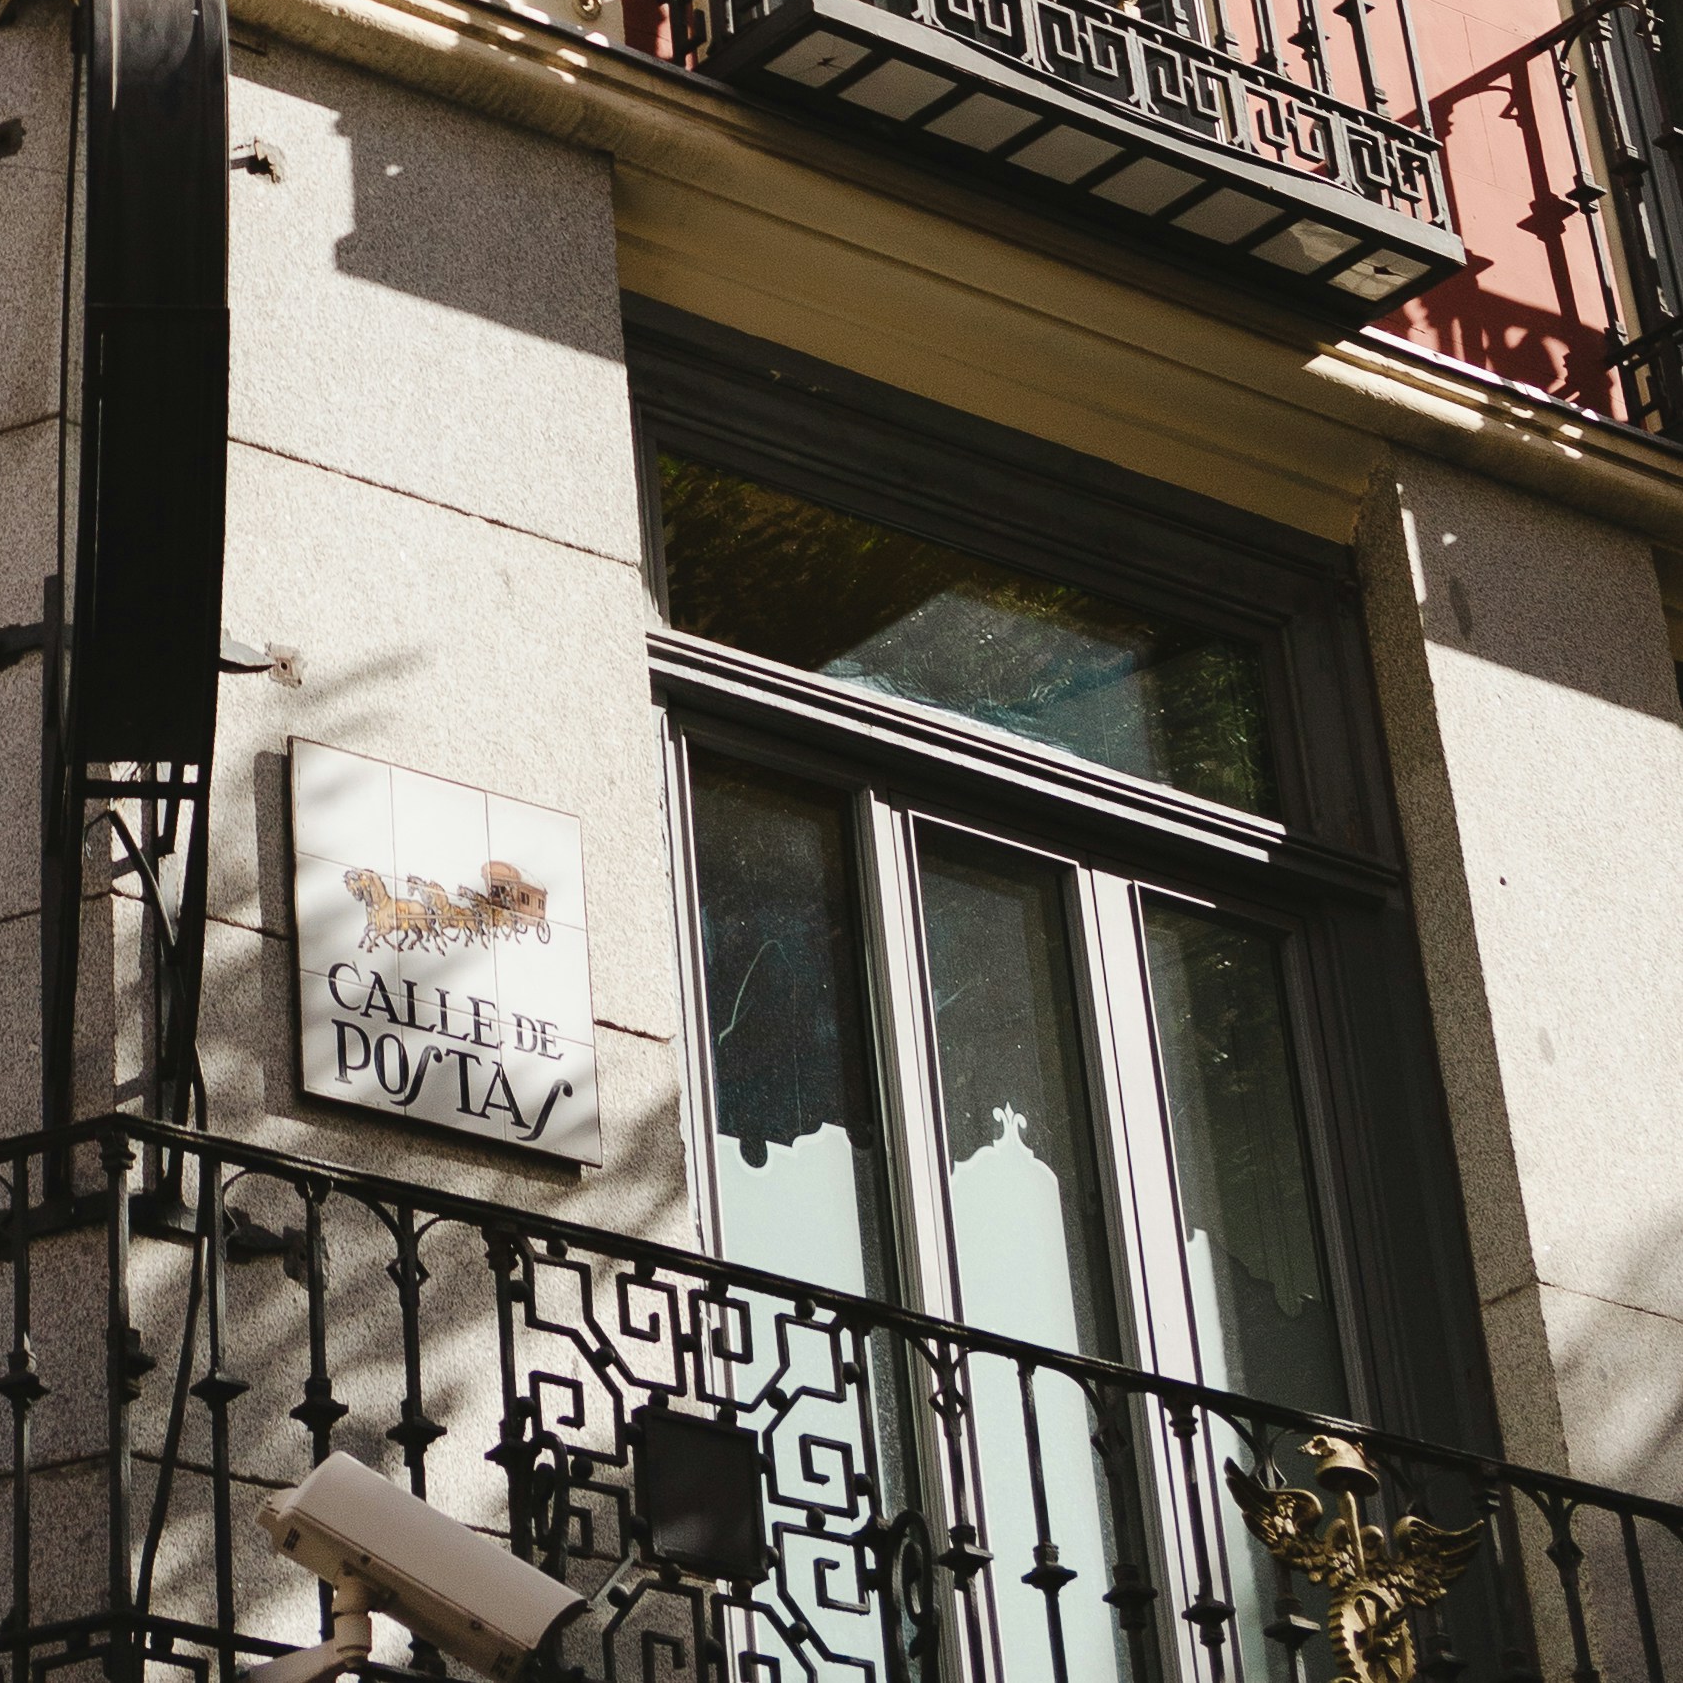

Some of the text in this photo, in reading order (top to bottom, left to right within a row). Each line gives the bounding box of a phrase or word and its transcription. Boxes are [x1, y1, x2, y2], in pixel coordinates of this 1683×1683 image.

[328, 961, 564, 1060] CALLE DE
[331, 1019, 573, 1141] POSTAS
